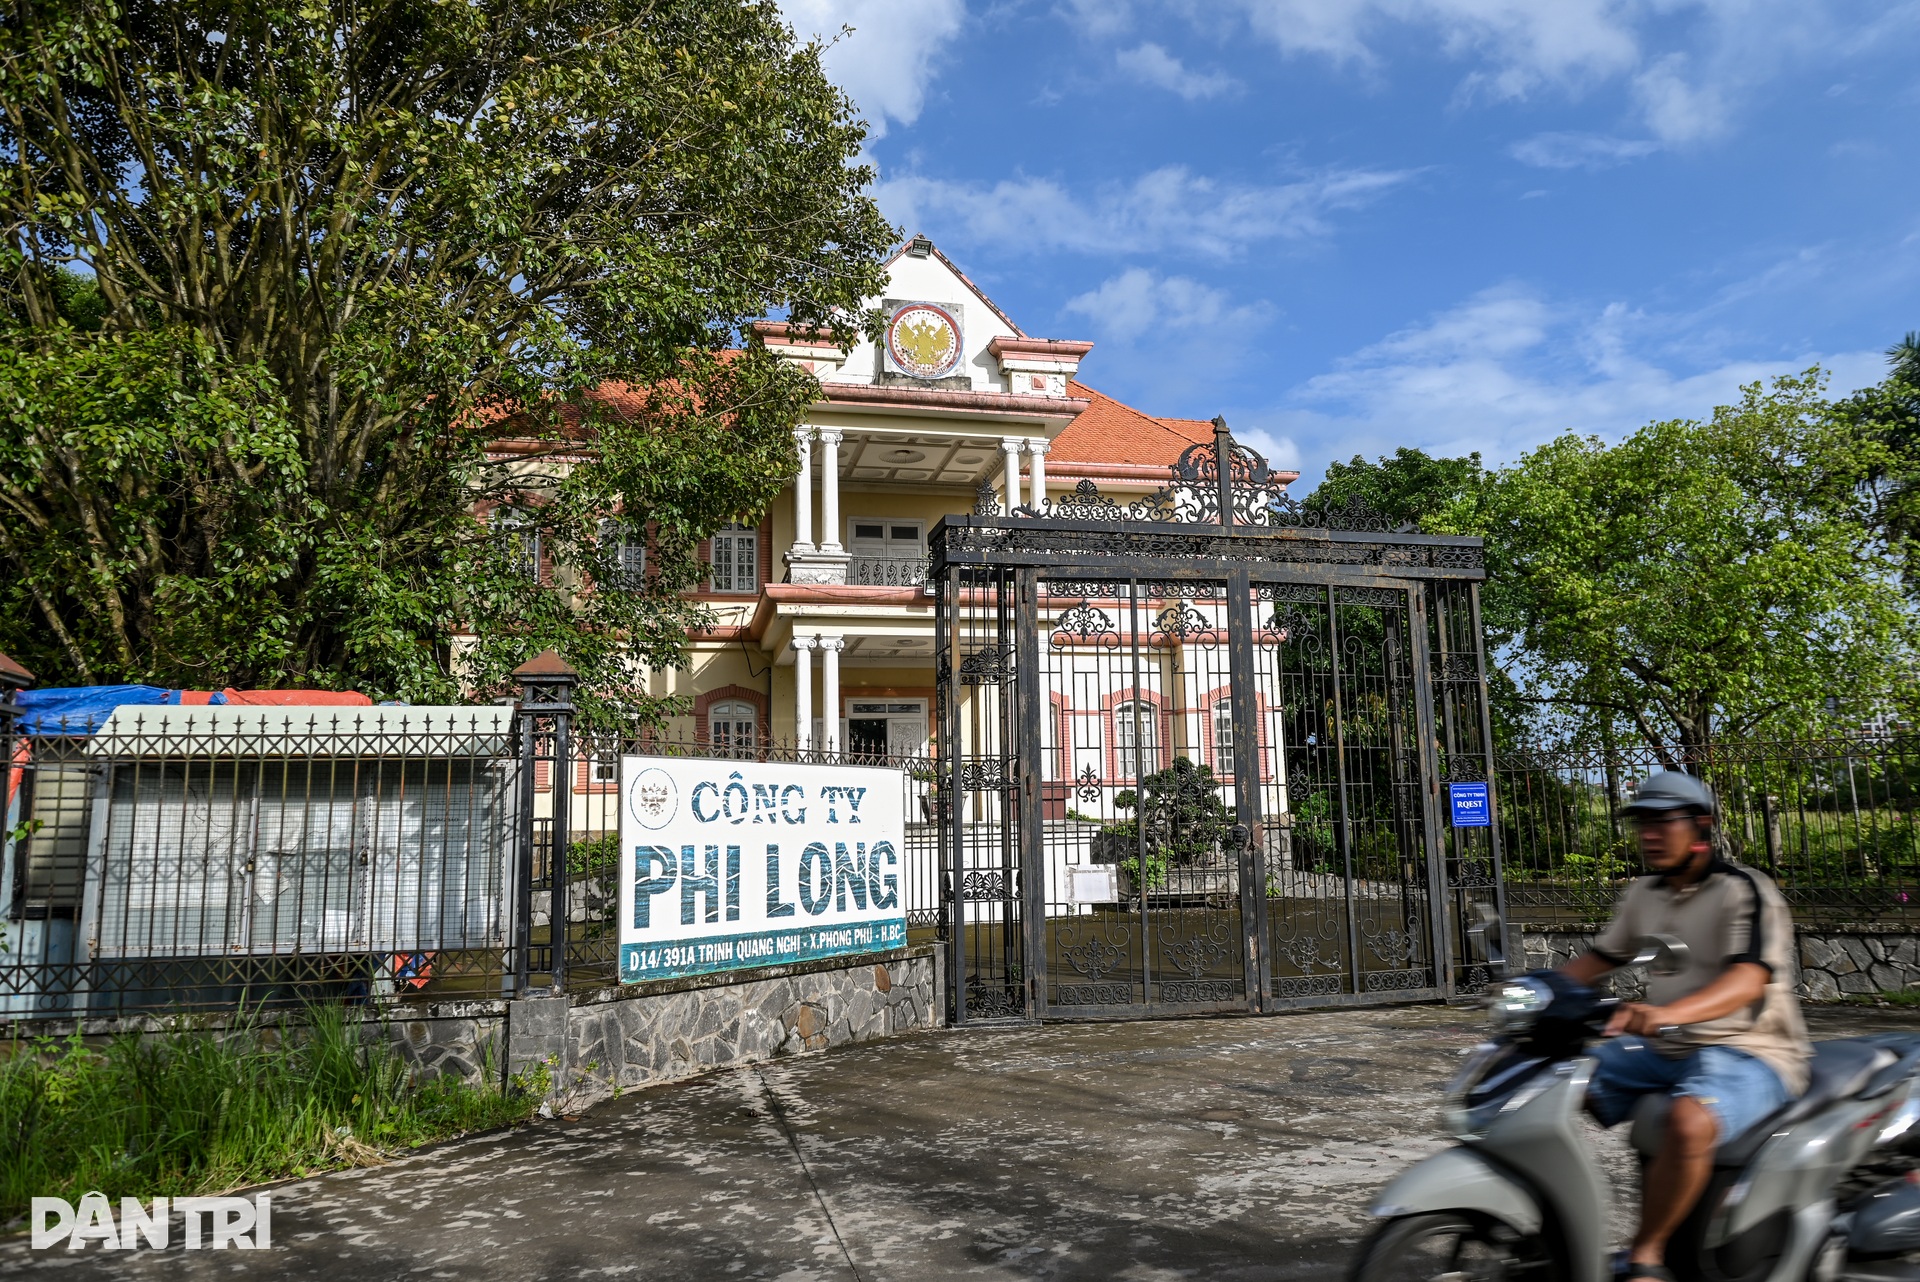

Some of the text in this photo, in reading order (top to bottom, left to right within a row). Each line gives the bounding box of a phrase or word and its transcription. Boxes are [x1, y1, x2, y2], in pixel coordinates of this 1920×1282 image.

[691, 770, 867, 825] CÔNG TY
[1456, 800, 1483, 809] RQEST
[633, 840, 898, 929] PHI LONG
[630, 945, 695, 971] D14/391A
[698, 941, 733, 965] TRỊNH
[736, 937, 774, 961] QUANG
[776, 934, 800, 955] NGHỊ
[810, 930, 852, 949] X.PHONG
[854, 923, 873, 945] PHÚ
[881, 924, 901, 942] H.BC
